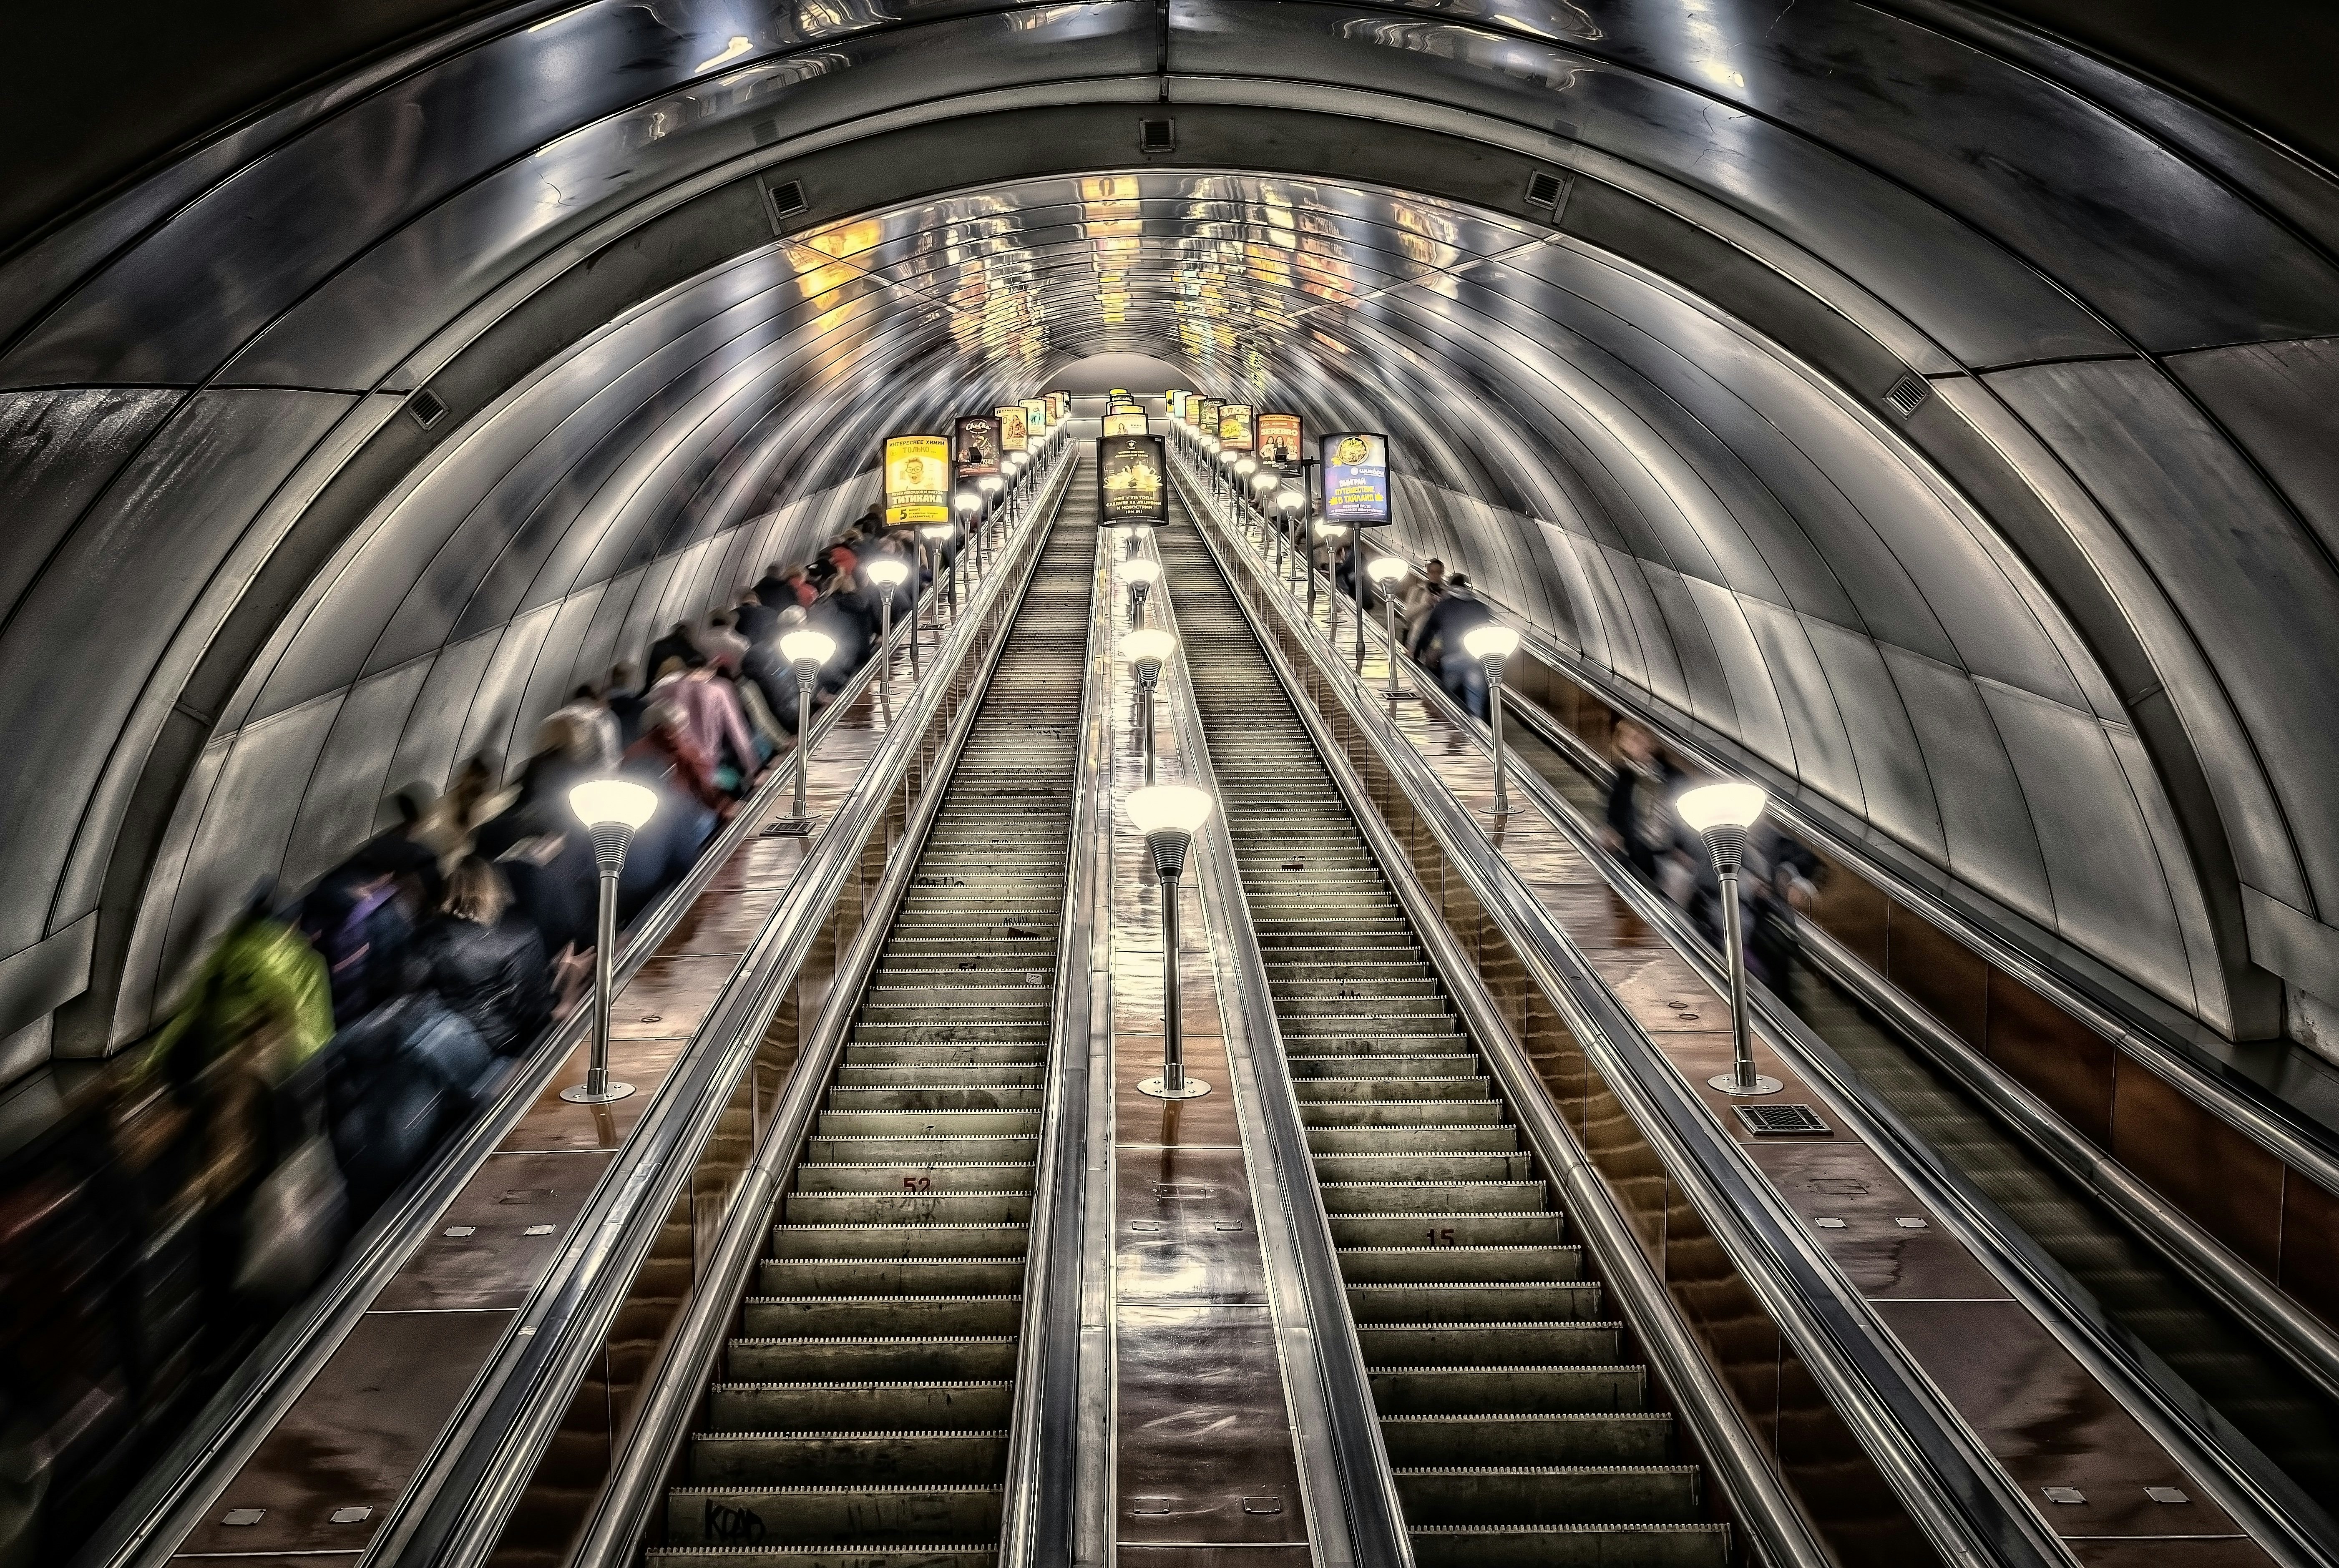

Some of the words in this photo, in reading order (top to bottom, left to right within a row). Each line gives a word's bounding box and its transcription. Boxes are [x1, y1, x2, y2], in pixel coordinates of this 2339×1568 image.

[1260, 428, 1298, 436] SEREBRO
[1339, 477, 1366, 487] ВЫИГРАЙ
[1335, 486, 1375, 495] ПУТЕШЕСТВИЕ
[892, 494, 943, 504] ТИТИКАКА
[1343, 494, 1374, 503] ТАЙЛАНД
[900, 508, 907, 520] 5
[594, 1078, 598, 1088] 1
[1172, 1077, 1177, 1086] 1
[904, 1177, 931, 1194] 52
[1426, 1229, 1454, 1248] 15
